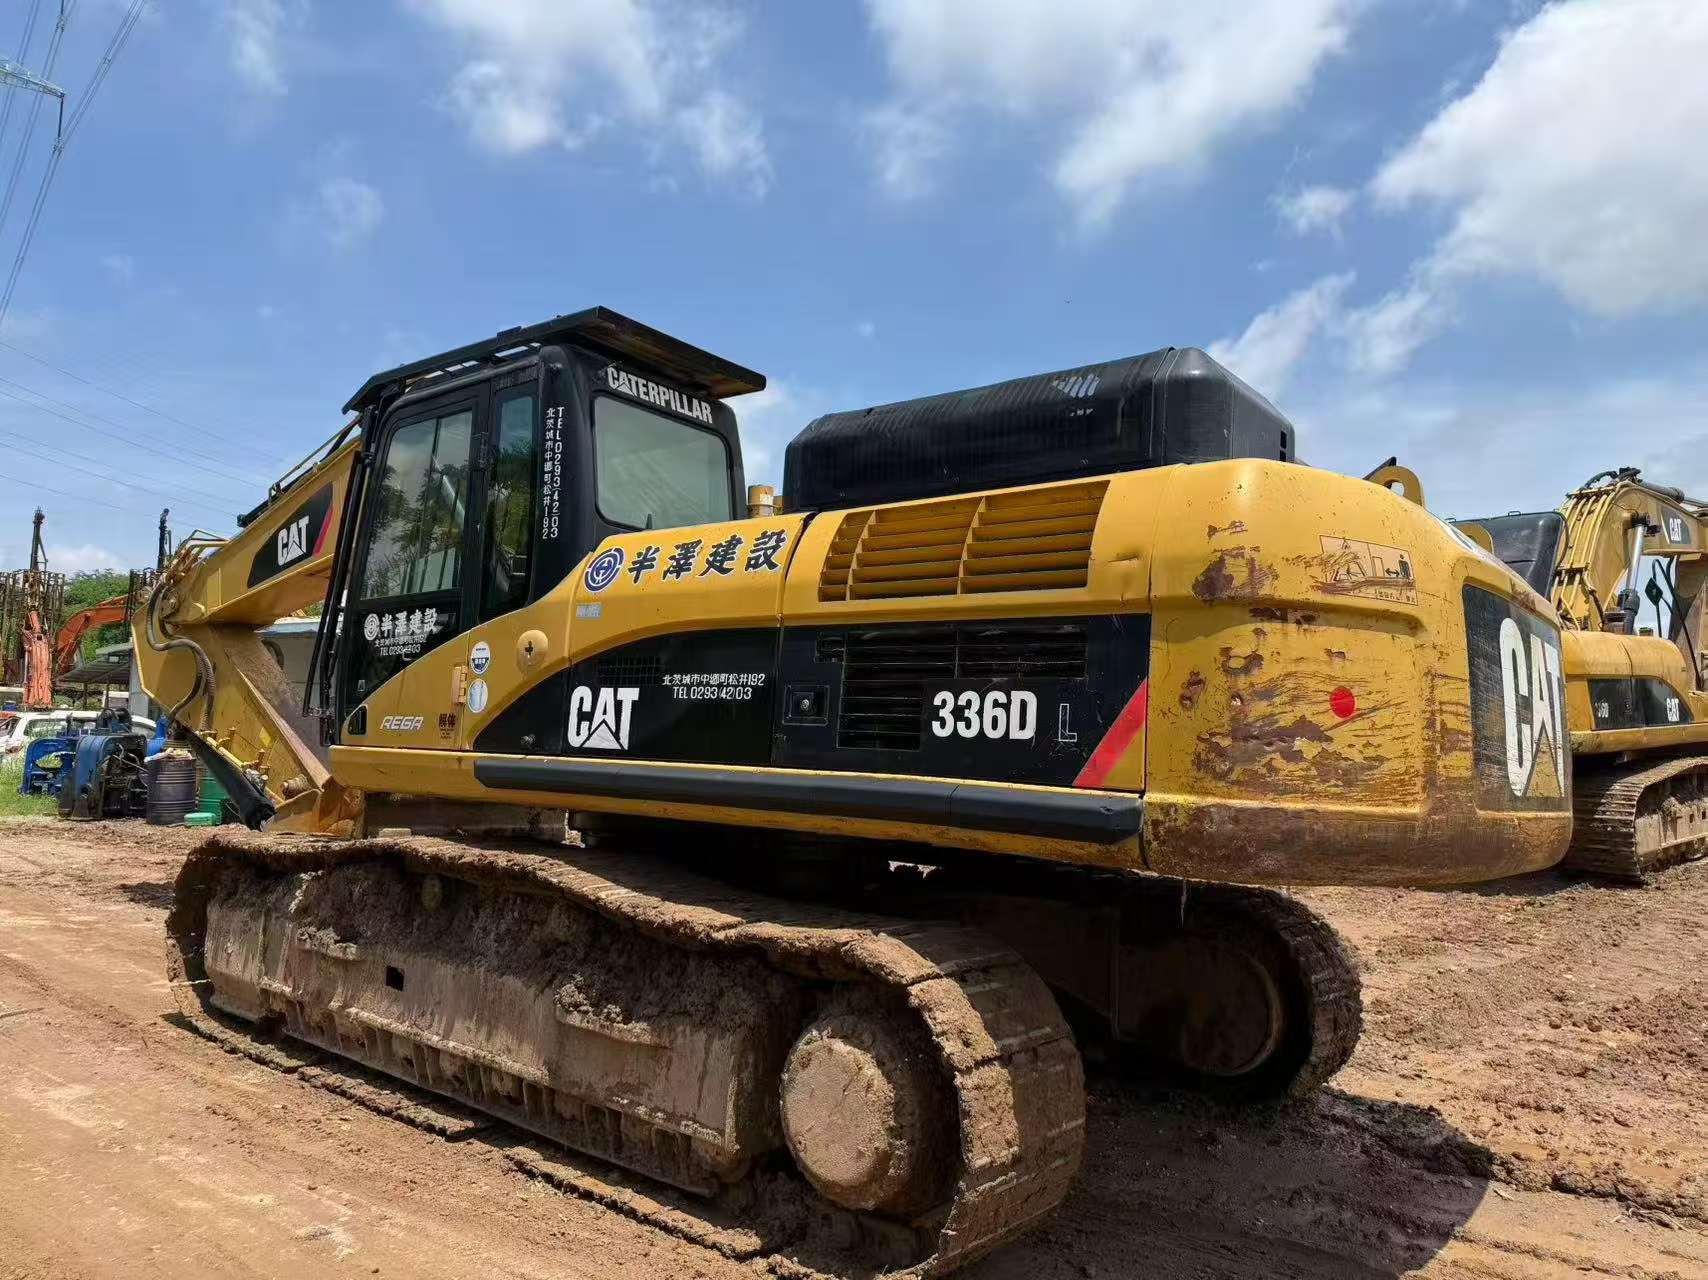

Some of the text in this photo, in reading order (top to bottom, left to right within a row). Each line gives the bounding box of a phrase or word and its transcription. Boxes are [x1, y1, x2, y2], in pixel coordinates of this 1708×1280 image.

[607, 365, 713, 424] CATERPILLAR
[277, 515, 310, 567] CAT
[1669, 517, 1682, 542] CAT
[627, 528, 787, 585] 半澤建設
[381, 607, 438, 637] 半澤建設
[661, 673, 766, 686] 北茨城市中郷町松井192
[672, 686, 688, 699] TEL
[567, 685, 640, 750] CAT
[931, 690, 1078, 742] 336D L
[1500, 617, 1565, 797] CAT
[1666, 698, 1679, 722] CAT
